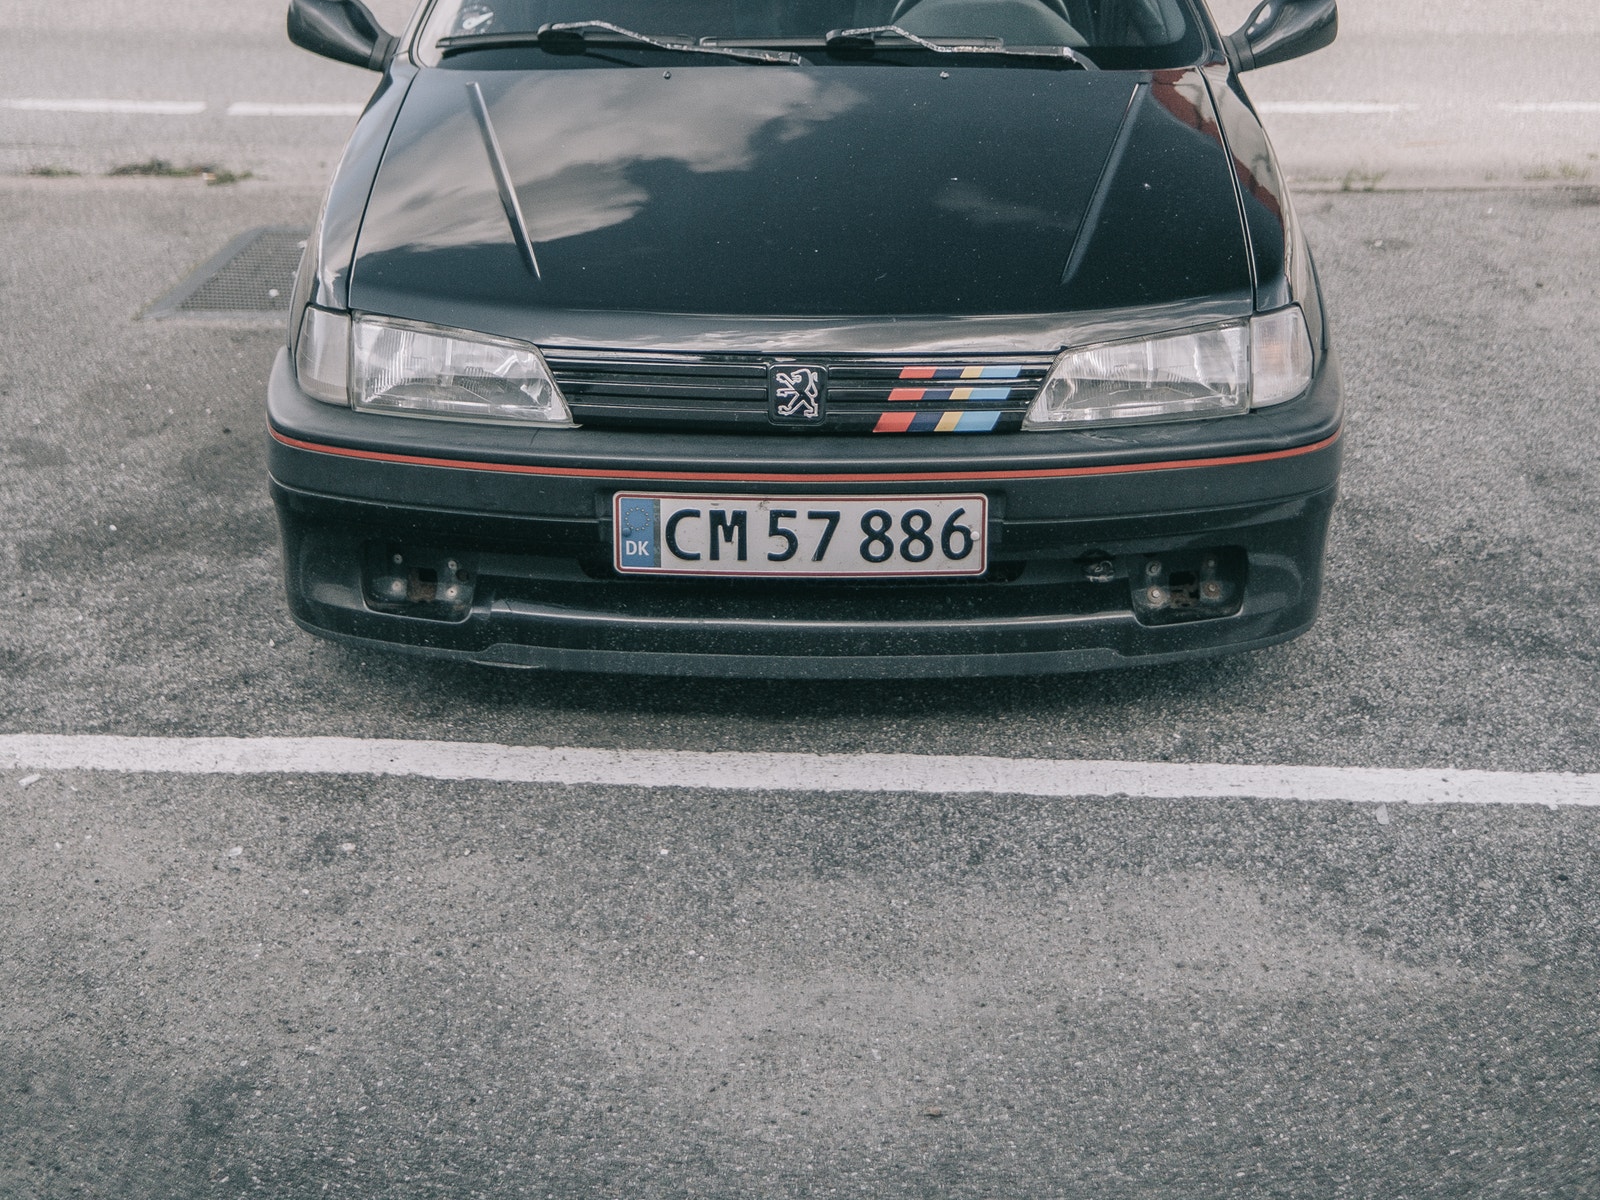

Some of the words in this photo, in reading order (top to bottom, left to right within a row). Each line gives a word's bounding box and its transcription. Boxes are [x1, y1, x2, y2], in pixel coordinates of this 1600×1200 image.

[625, 540, 651, 557] DK
[665, 508, 748, 561] CM
[766, 509, 841, 561] 57
[859, 507, 974, 563] 886
